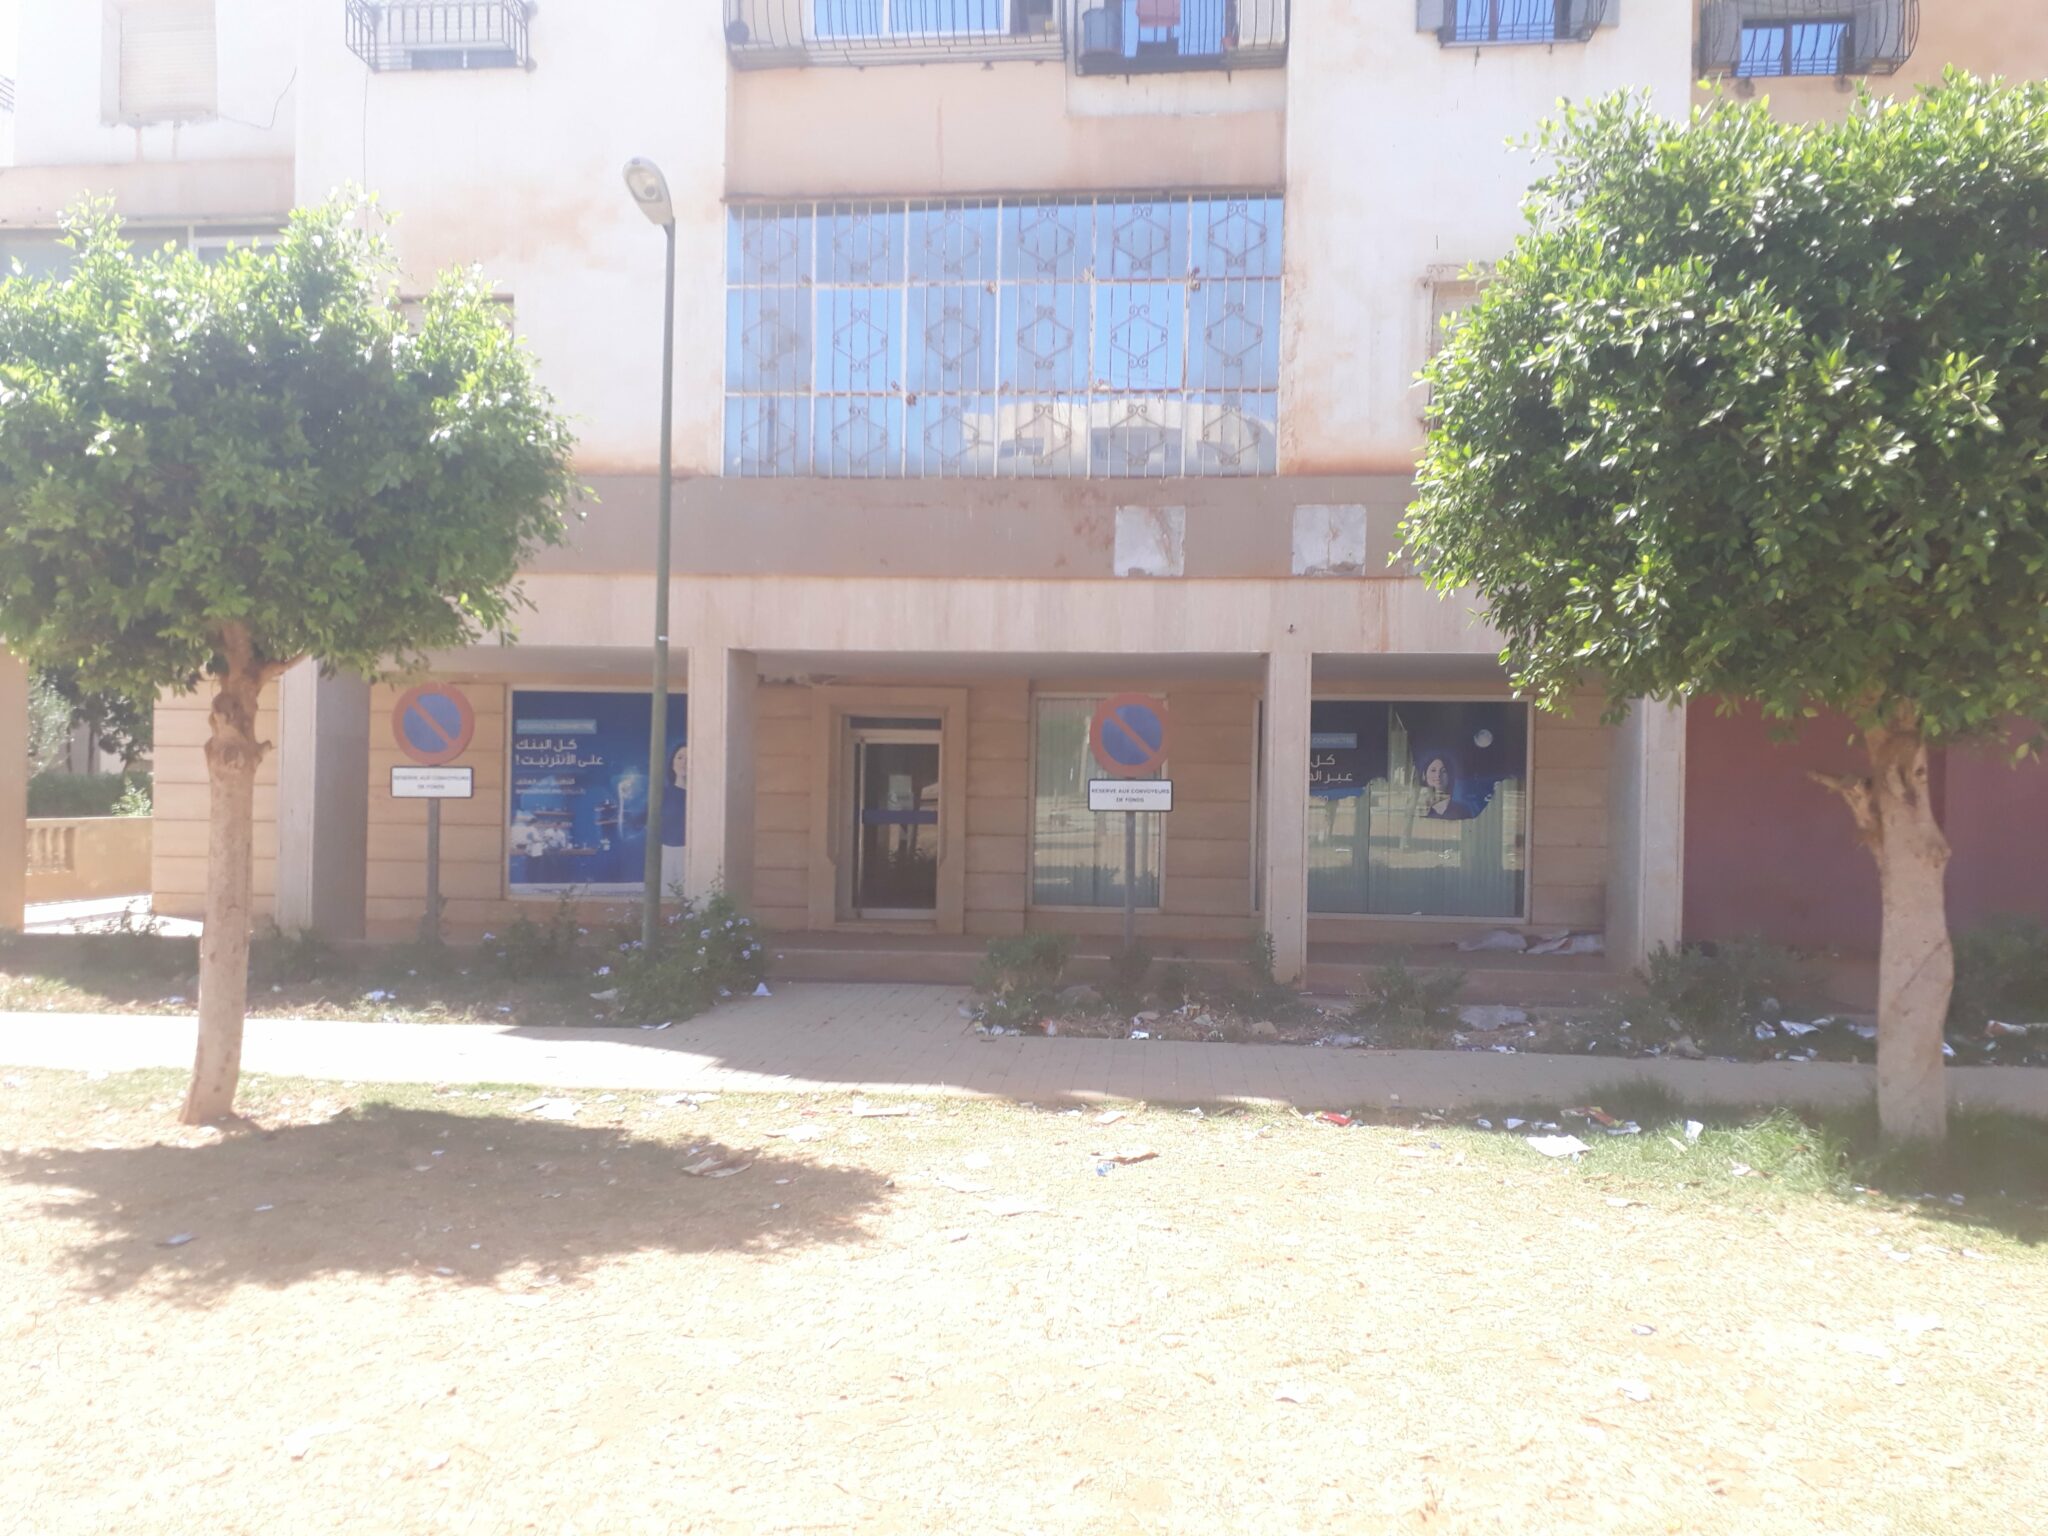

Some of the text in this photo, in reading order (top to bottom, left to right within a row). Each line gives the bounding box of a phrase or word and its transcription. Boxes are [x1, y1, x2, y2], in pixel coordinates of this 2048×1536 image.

[553, 739, 577, 752] كل
[577, 754, 604, 768] على
[1310, 754, 1336, 768] كل
[1323, 773, 1353, 784] عبر
